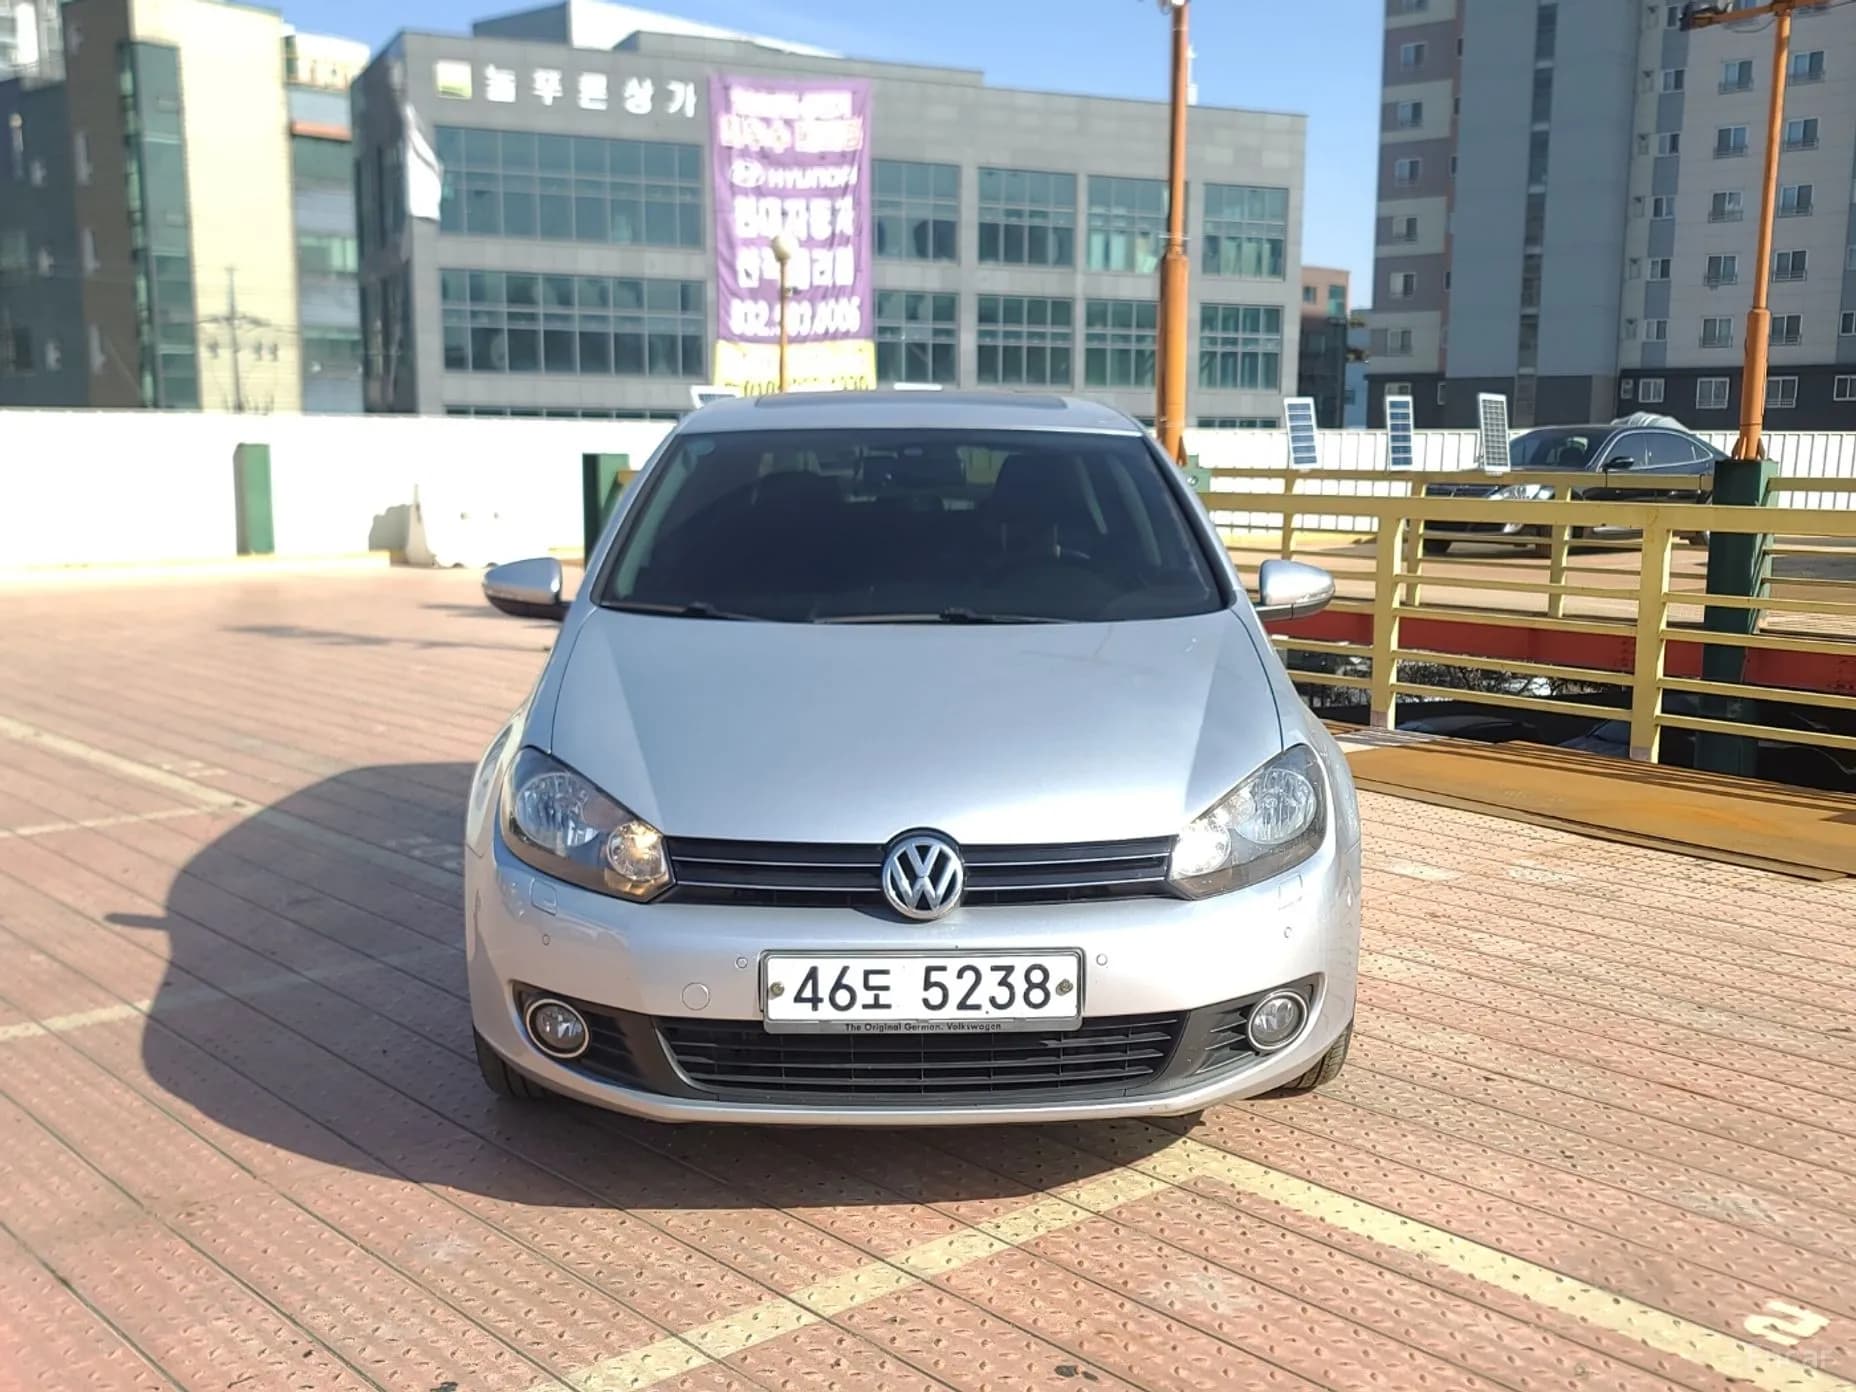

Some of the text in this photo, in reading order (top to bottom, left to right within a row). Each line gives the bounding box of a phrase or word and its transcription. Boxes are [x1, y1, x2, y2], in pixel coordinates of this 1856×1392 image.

[793, 963, 1051, 1011] 46도 5238
[844, 1023, 862, 1032] The
[864, 1023, 901, 1033] Original
[946, 1021, 1002, 1033] Volkswagen
